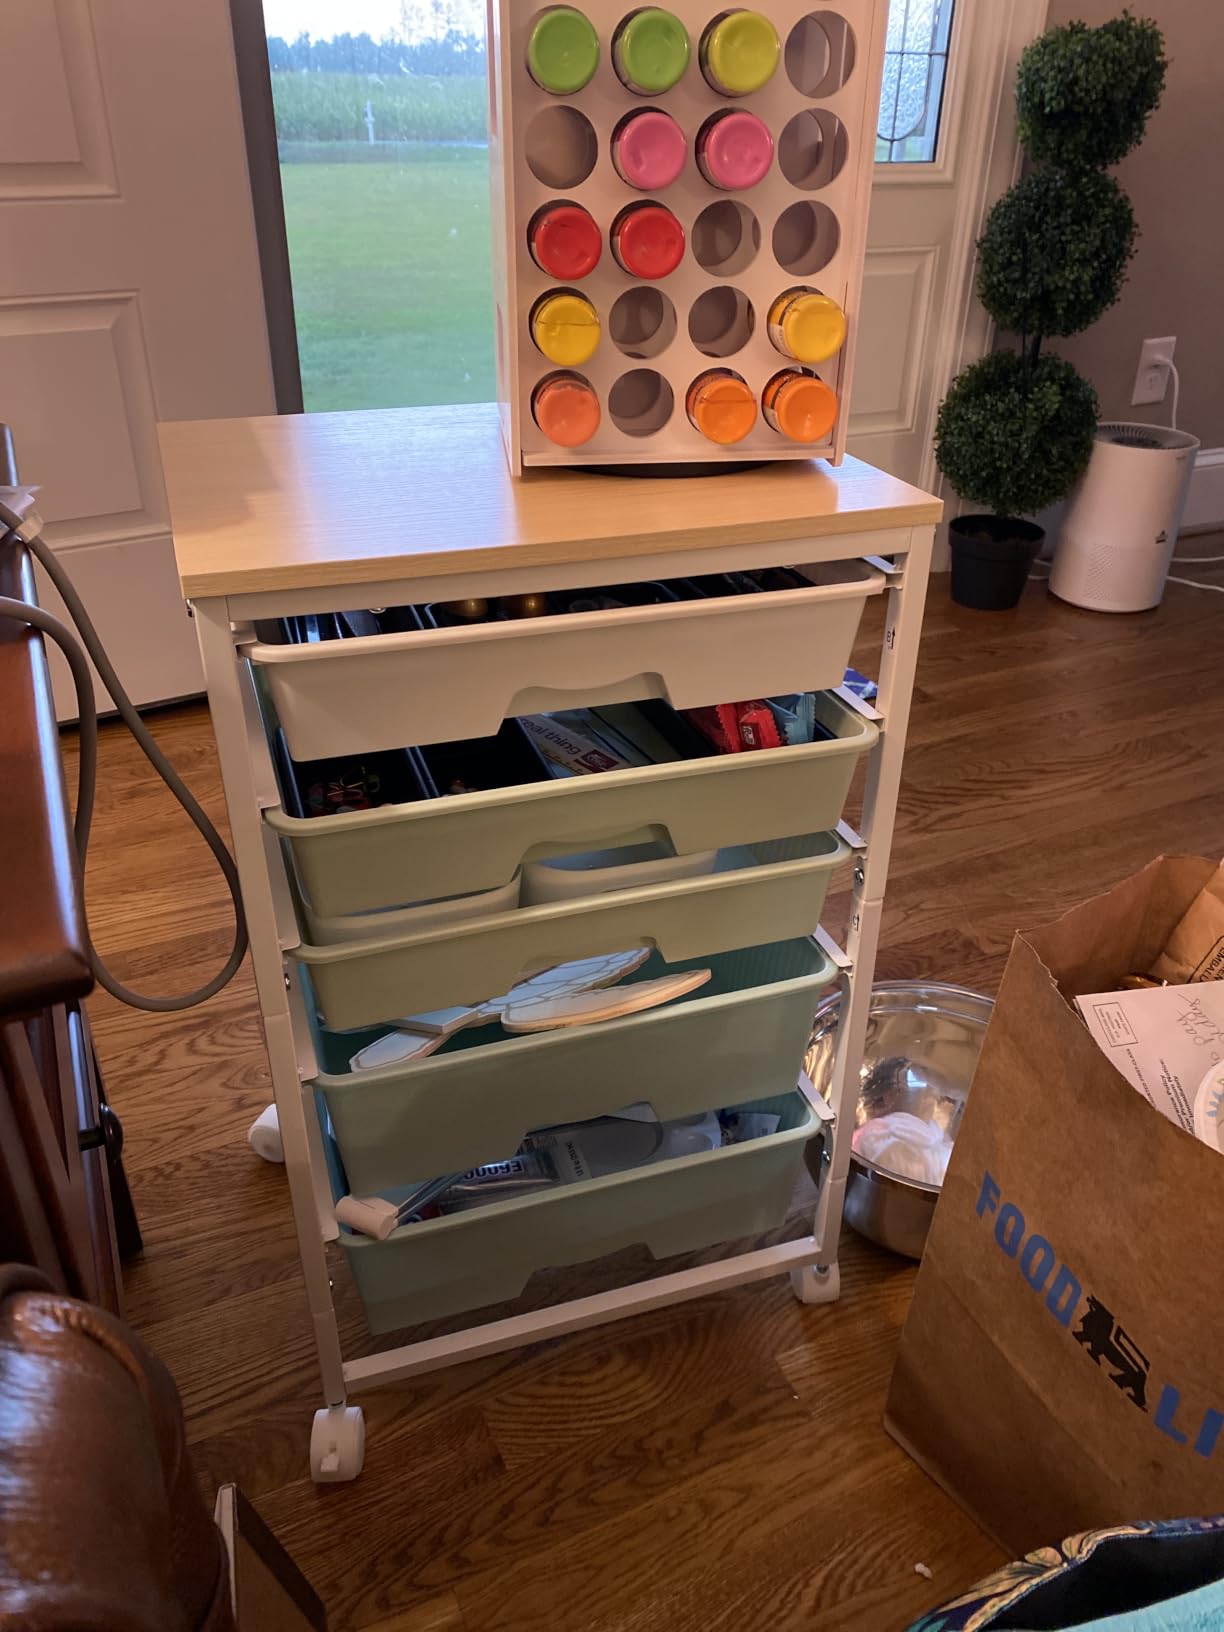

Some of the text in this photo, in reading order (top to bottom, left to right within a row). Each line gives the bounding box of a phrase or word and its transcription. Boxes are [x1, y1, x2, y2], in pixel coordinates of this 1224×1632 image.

[545, 732, 581, 756] thing
[1159, 1074, 1187, 1130] nsurance Policy
[976, 1170, 1082, 1328] FOOD
